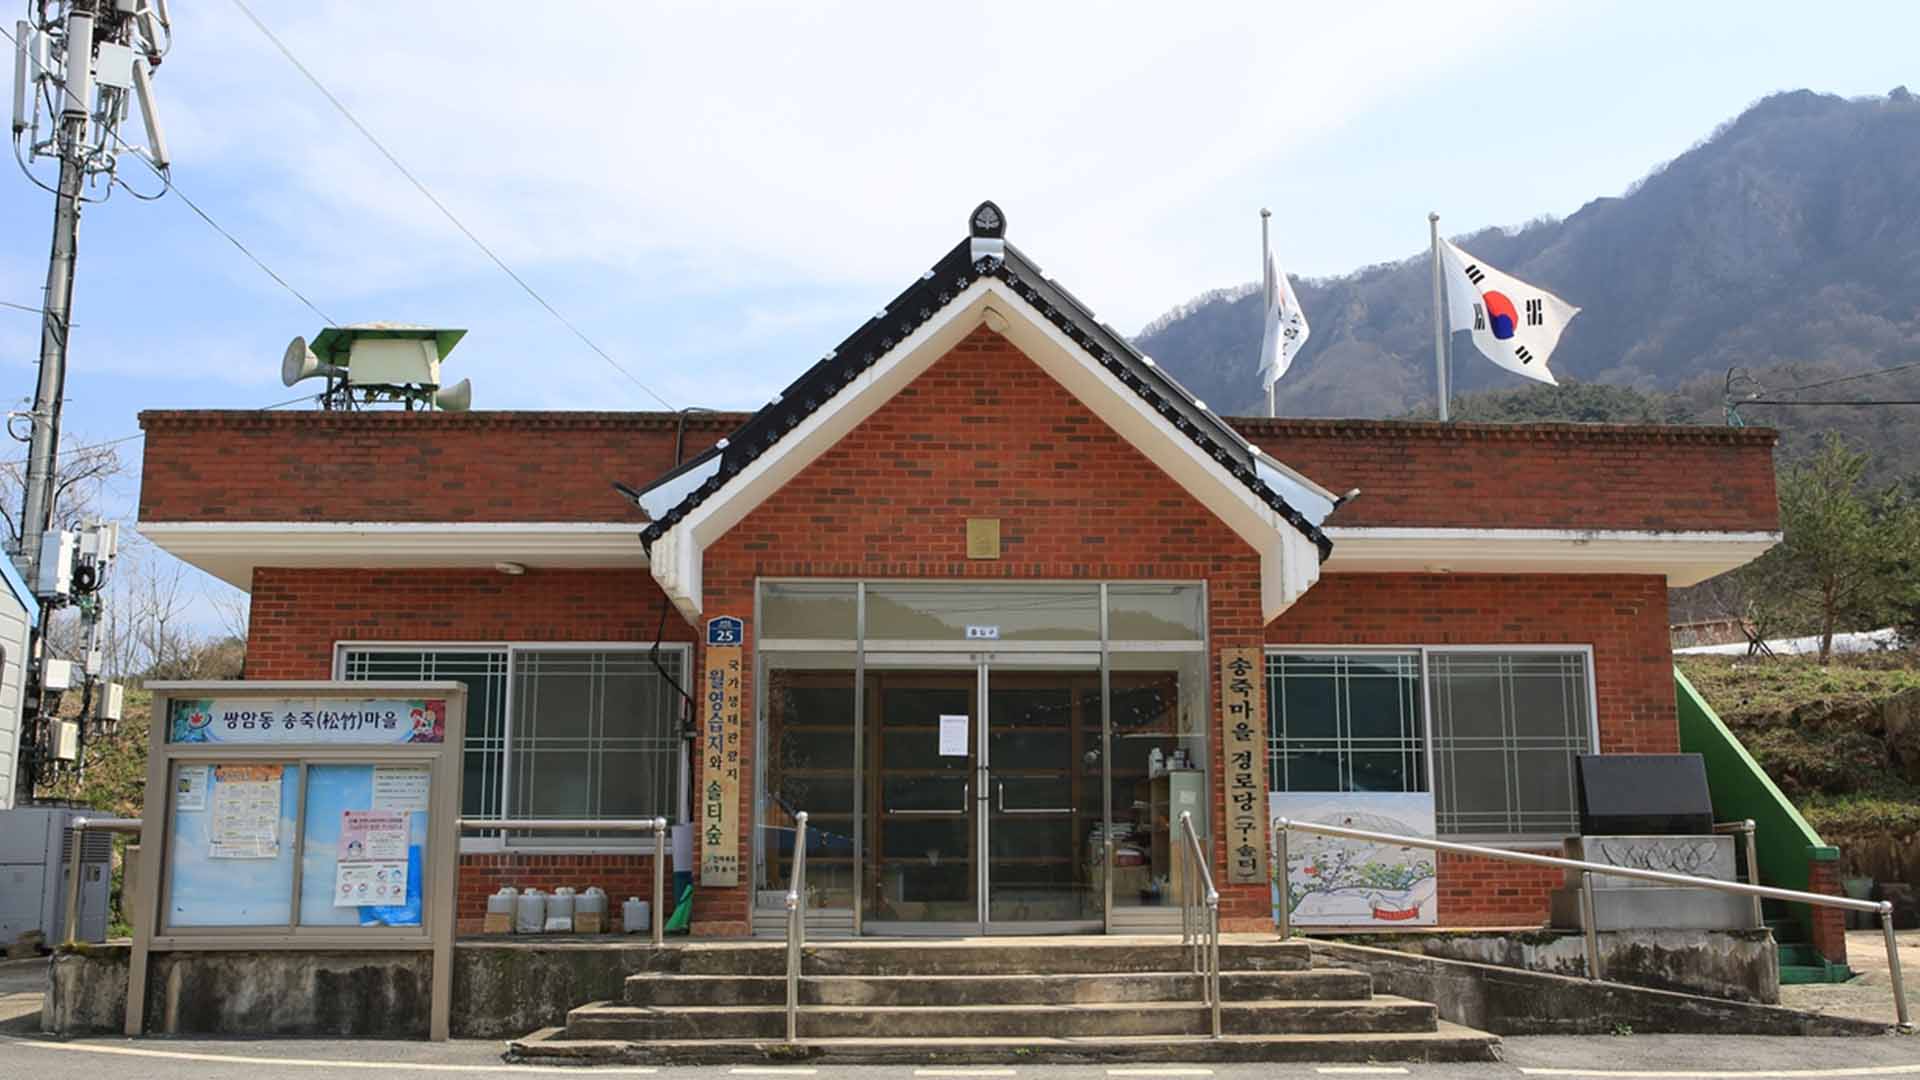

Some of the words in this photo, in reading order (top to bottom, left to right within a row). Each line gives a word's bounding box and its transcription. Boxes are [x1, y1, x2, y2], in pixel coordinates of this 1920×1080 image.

[717, 630, 733, 641] 25
[223, 710, 274, 730] 쌍암동
[281, 710, 398, 730] 송죽(松竹)마을
[708, 669, 725, 771] 월영습지와
[1227, 656, 1254, 742] 송죽마을
[706, 779, 723, 846] 솔티숲
